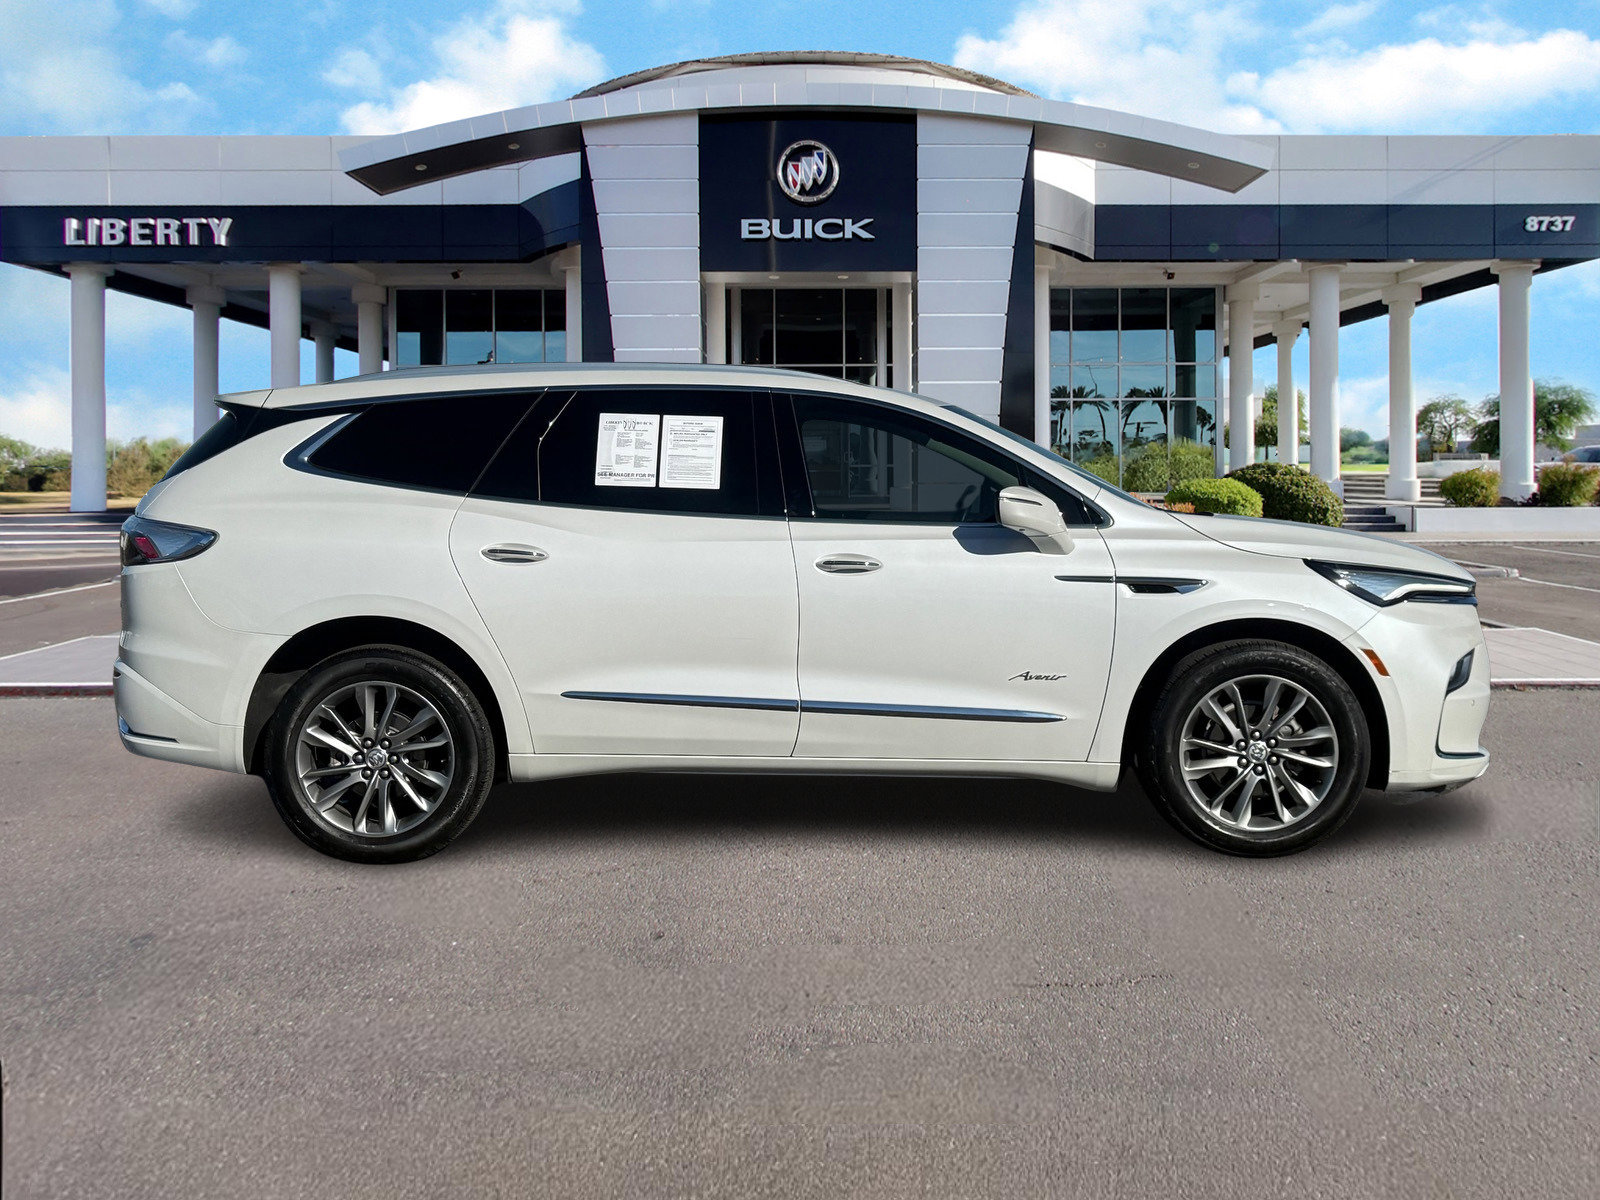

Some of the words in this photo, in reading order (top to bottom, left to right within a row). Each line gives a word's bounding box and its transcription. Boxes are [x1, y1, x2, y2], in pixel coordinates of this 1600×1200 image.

[63, 217, 233, 247] LIBERTY
[740, 218, 876, 239] BUICK
[1524, 215, 1576, 232] 8737
[1008, 670, 1067, 681] Avenir
